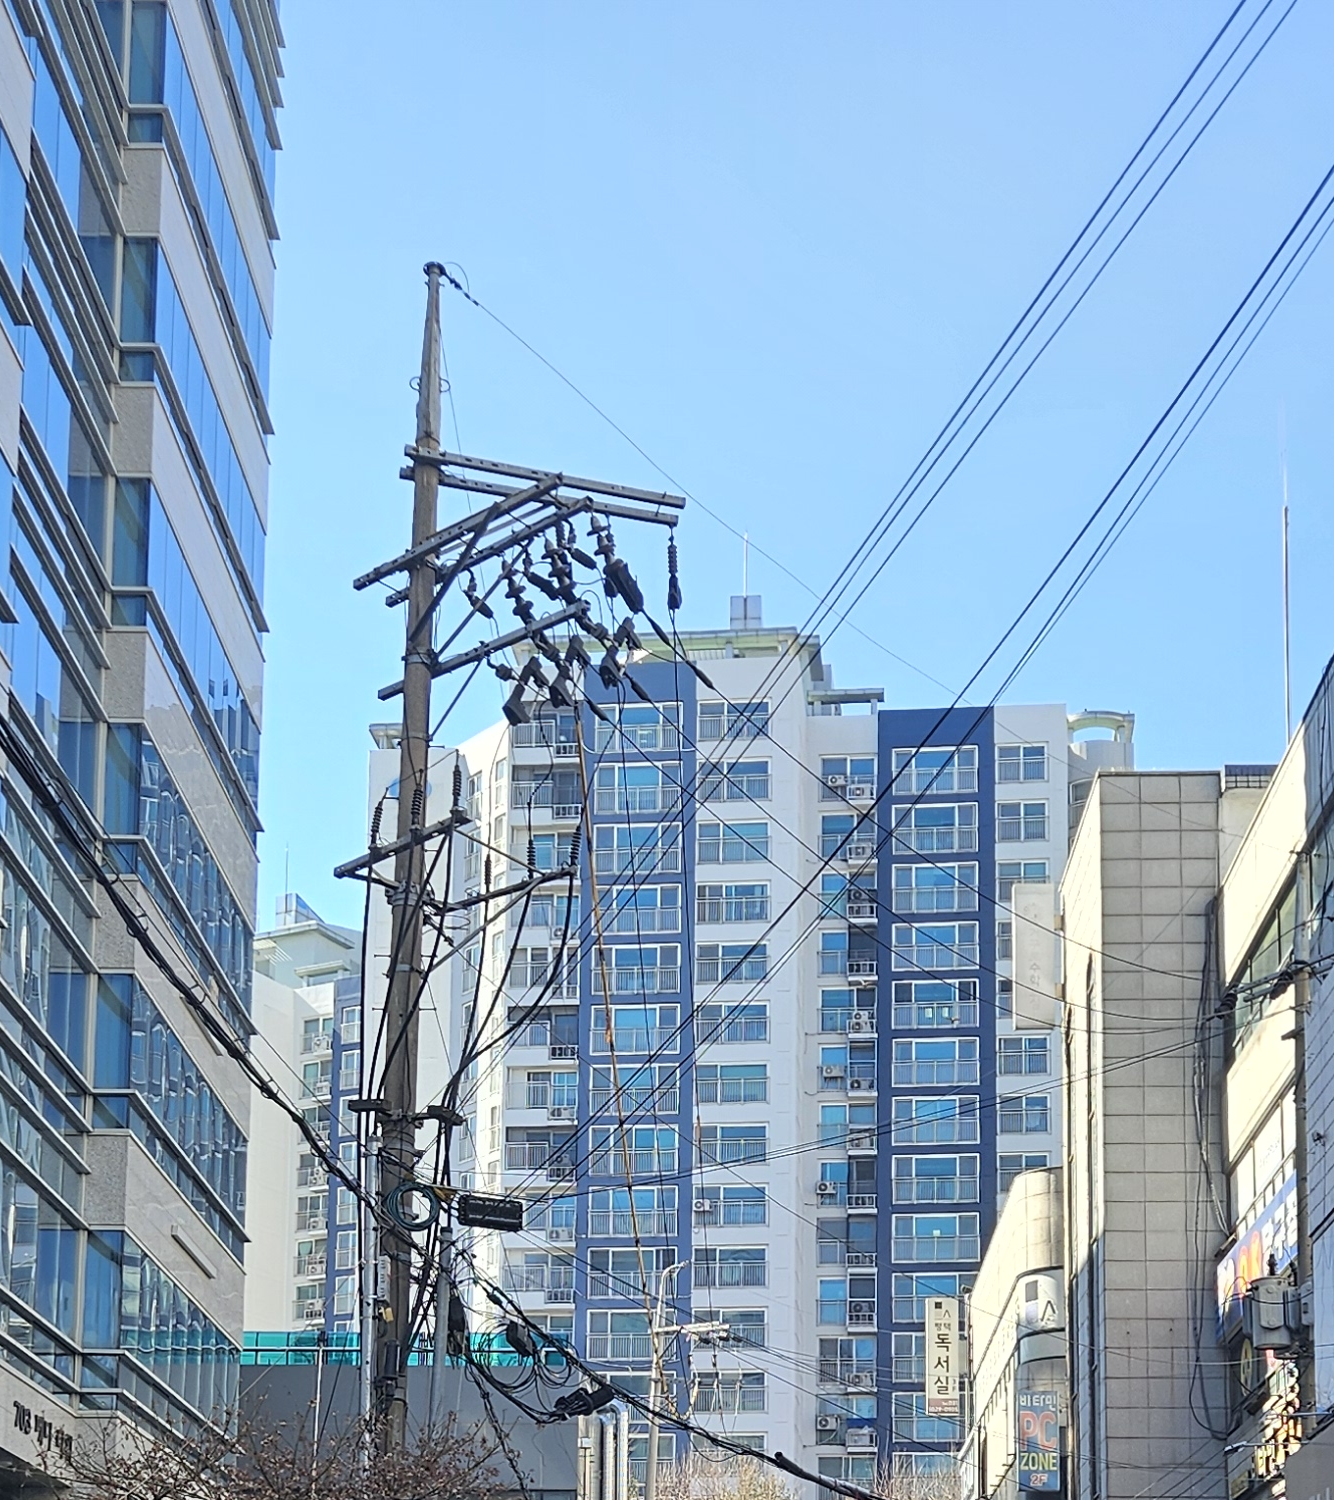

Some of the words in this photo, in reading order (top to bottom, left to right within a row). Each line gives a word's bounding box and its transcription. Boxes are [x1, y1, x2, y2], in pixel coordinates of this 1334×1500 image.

[934, 1333, 952, 1396] 독서실
[1019, 1394, 1057, 1410] 비타민
[1020, 1411, 1057, 1452] PC
[1020, 1452, 1058, 1471] ZONE
[1030, 1474, 1048, 1486] 2F
